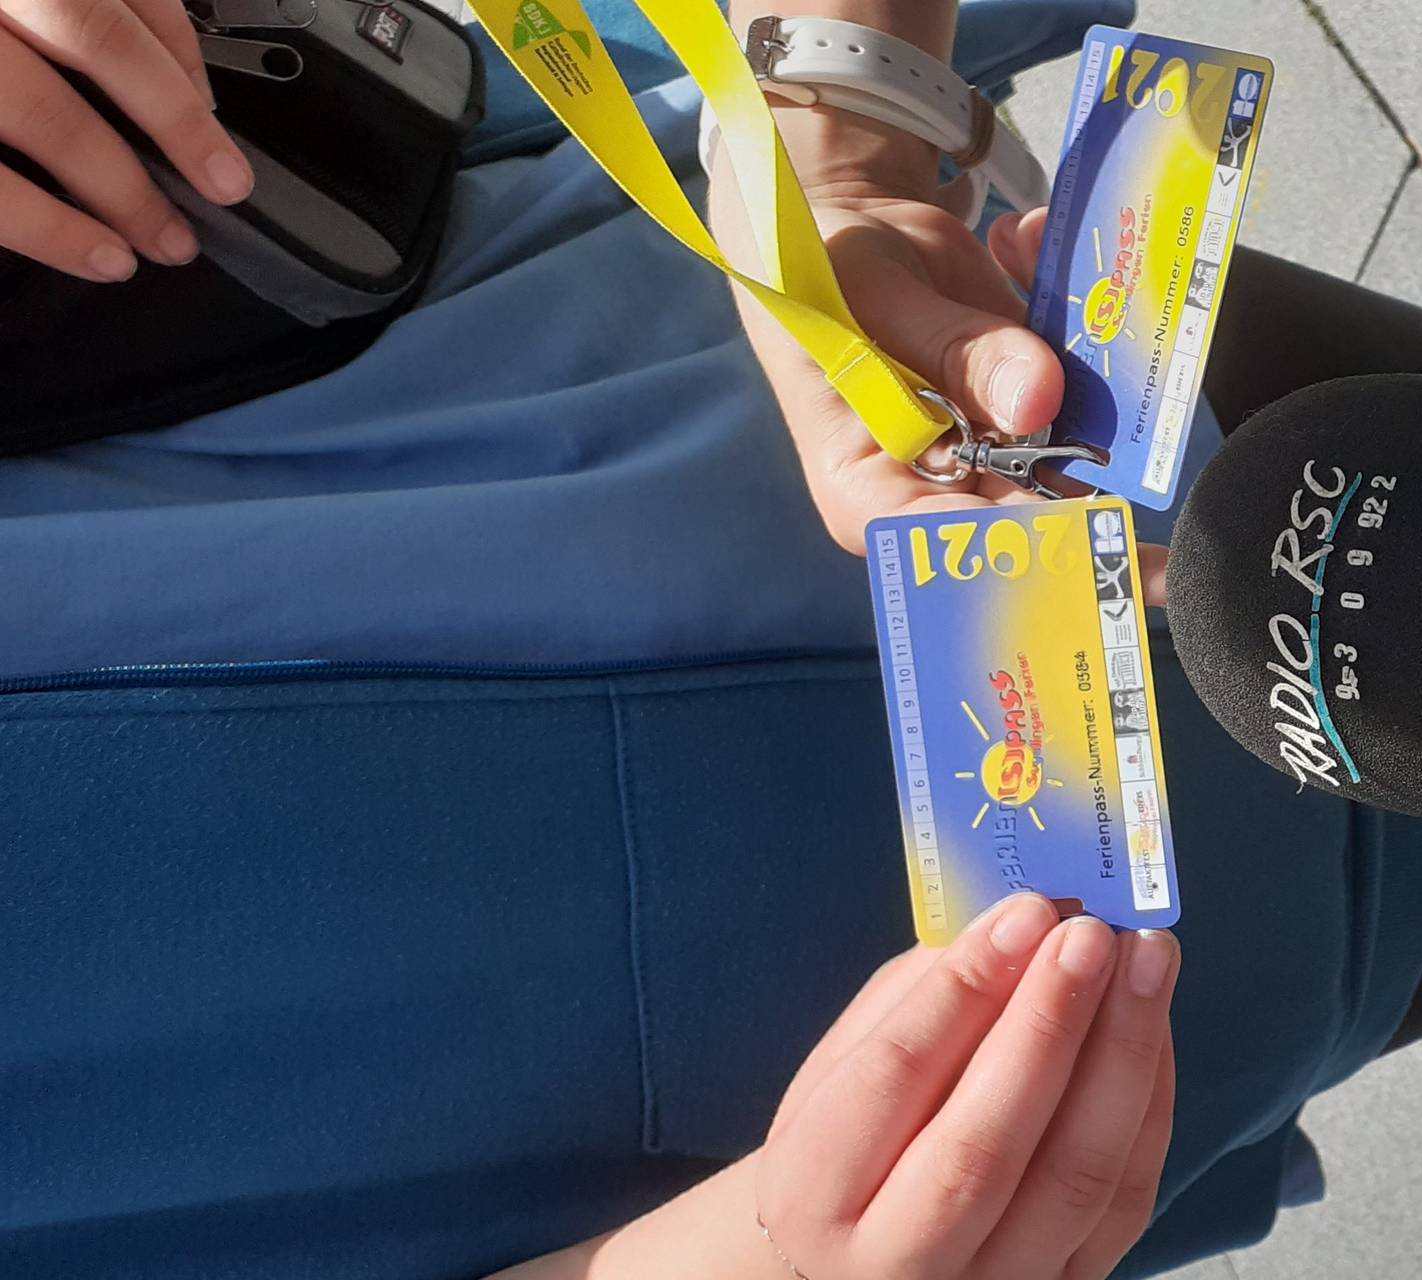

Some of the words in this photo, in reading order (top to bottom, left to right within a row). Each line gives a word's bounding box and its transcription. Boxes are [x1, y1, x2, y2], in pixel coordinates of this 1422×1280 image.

[1102, 44, 1226, 122] 2021
[1131, 255, 1185, 444] Ferienpass-Nummer:
[1177, 206, 1194, 247] 0586
[882, 538, 894, 553] 15
[909, 513, 1079, 587] 2021
[886, 562, 897, 577] 14
[889, 589, 901, 604] 13
[892, 616, 904, 630] 12
[896, 643, 908, 657] 11
[899, 668, 911, 683] 10
[1075, 651, 1091, 691] 0584
[1266, 613, 1340, 787] RADIO
[1083, 699, 1115, 878] Ferienpass-Nummer:
